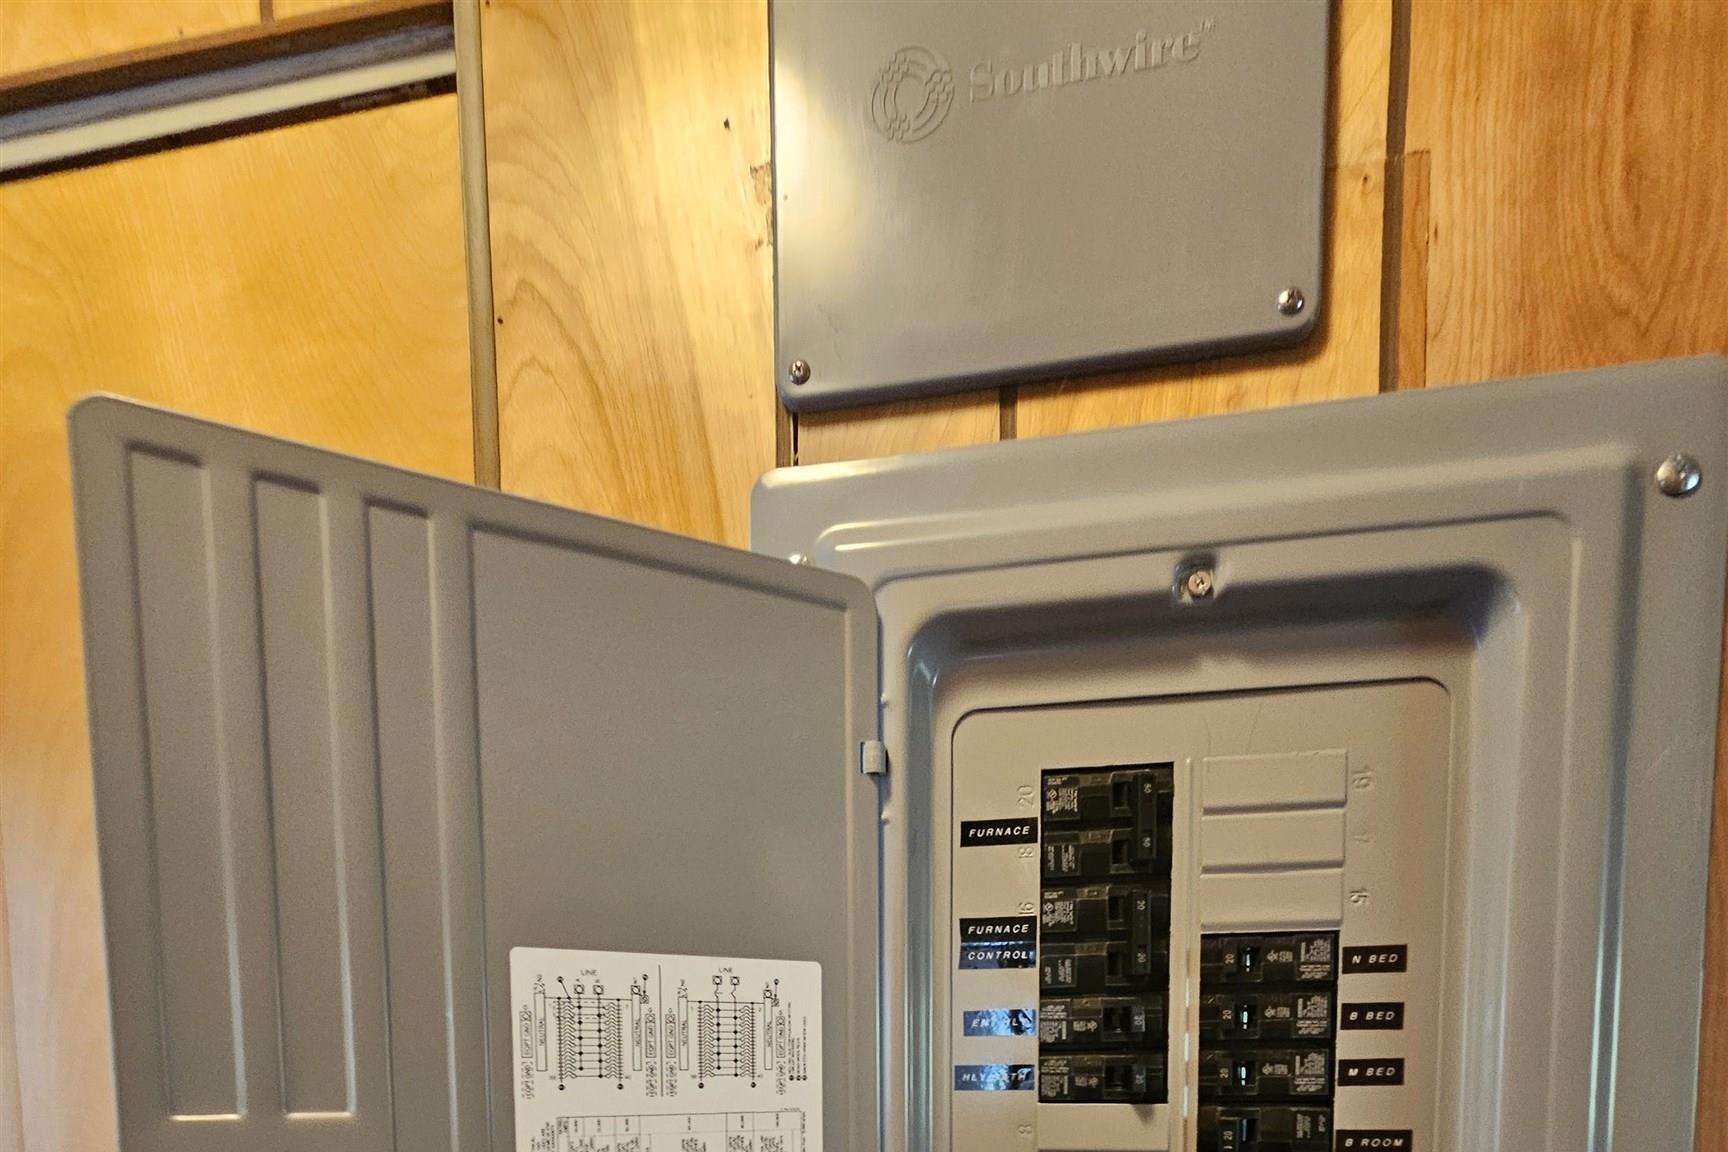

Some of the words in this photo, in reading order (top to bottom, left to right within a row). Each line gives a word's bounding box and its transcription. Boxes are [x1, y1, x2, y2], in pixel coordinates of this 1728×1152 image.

[970, 29, 1201, 104] Southwire
[968, 825, 1031, 838] FURNACE
[967, 924, 1030, 936] FURNACE
[967, 950, 1029, 961] CONTROL
[1225, 953, 1234, 964] 20
[1352, 955, 1361, 964] N
[1368, 953, 1398, 964] BED
[1222, 1009, 1232, 1019] 20
[1349, 1011, 1358, 1020] B
[1366, 1011, 1395, 1020] BED
[1366, 1067, 1396, 1076] BED
[1345, 1138, 1354, 1147] B
[1360, 1138, 1404, 1147] ROOM
